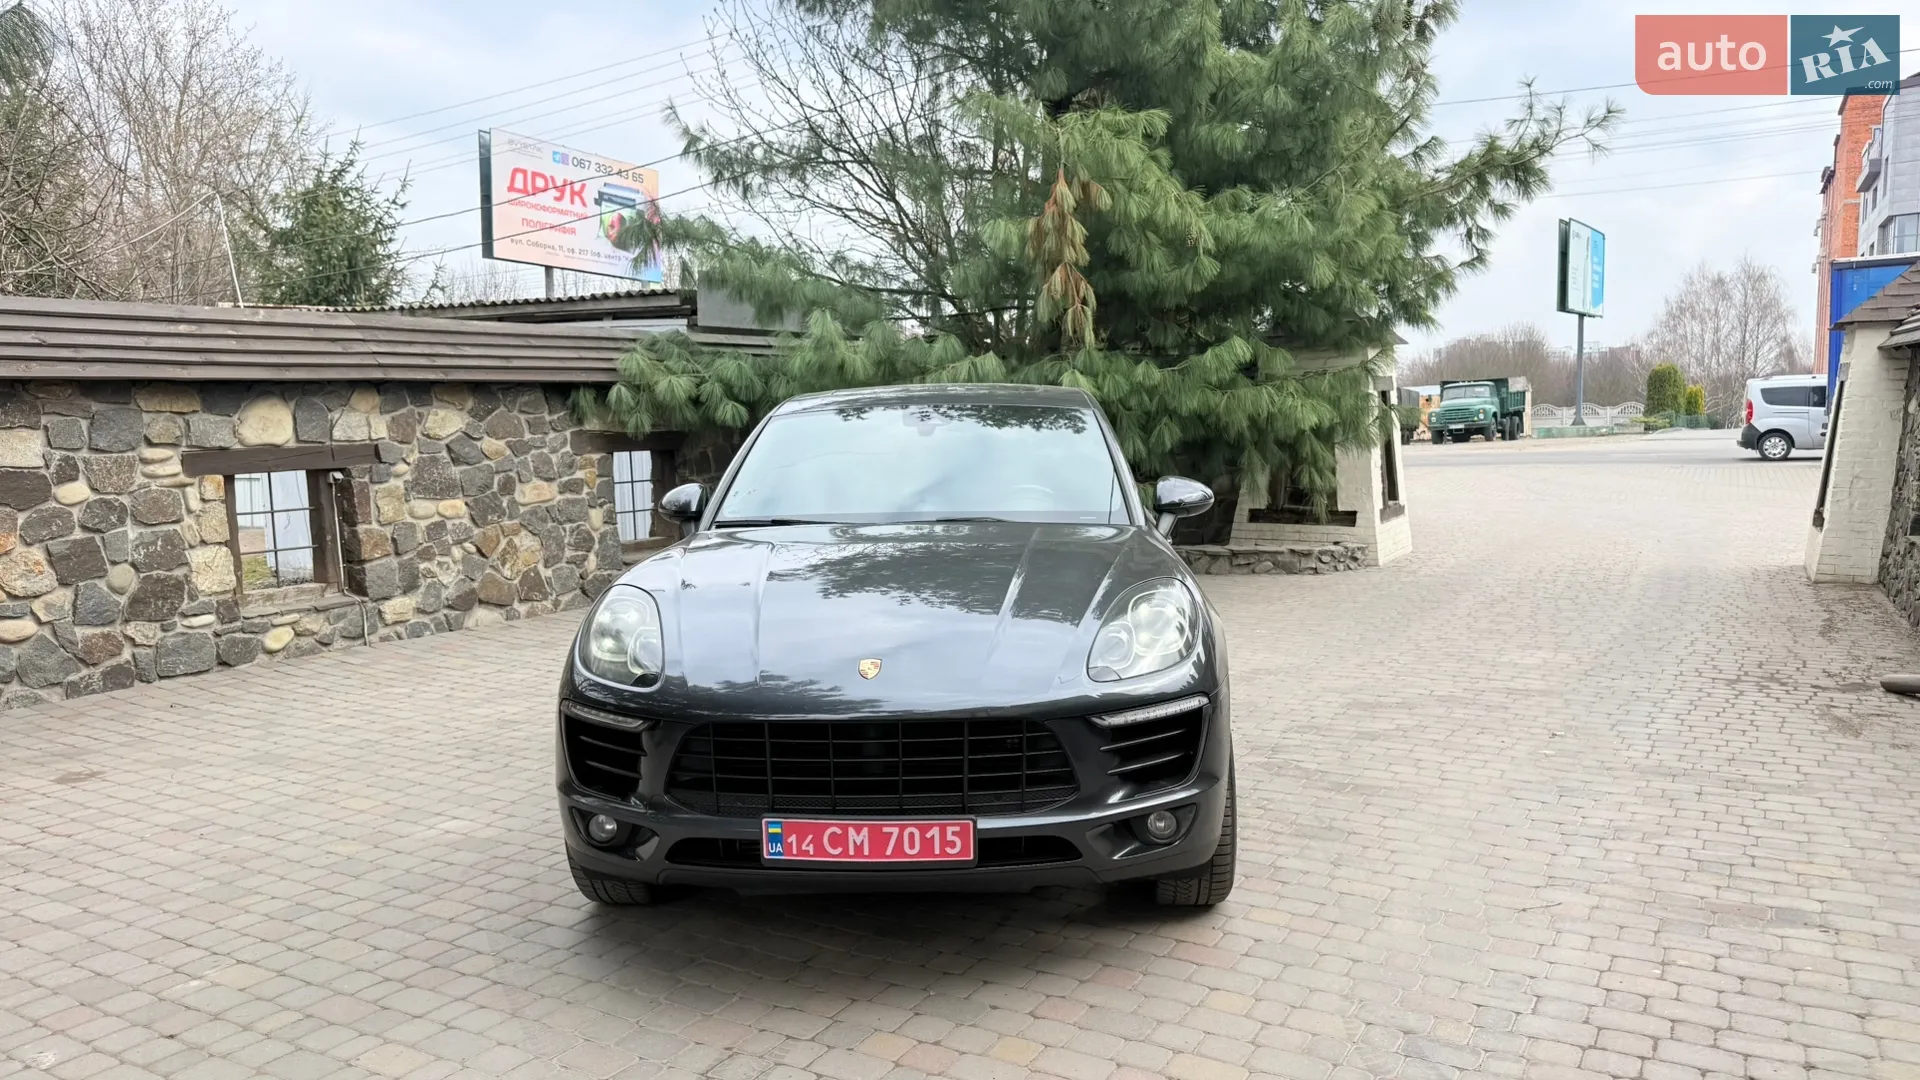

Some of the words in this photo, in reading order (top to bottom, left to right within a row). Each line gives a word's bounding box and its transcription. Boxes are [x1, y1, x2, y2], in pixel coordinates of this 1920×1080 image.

[571, 156, 592, 171] 067
[595, 162, 613, 175] 332
[616, 168, 629, 180] 43
[632, 172, 644, 183] 65
[507, 167, 588, 208] ДРУК
[521, 218, 577, 236] ПОЛІГРАФІЯ
[769, 843, 783, 853] UA
[787, 834, 813, 855] 14
[823, 826, 870, 855] CM
[882, 826, 962, 855] 7015
